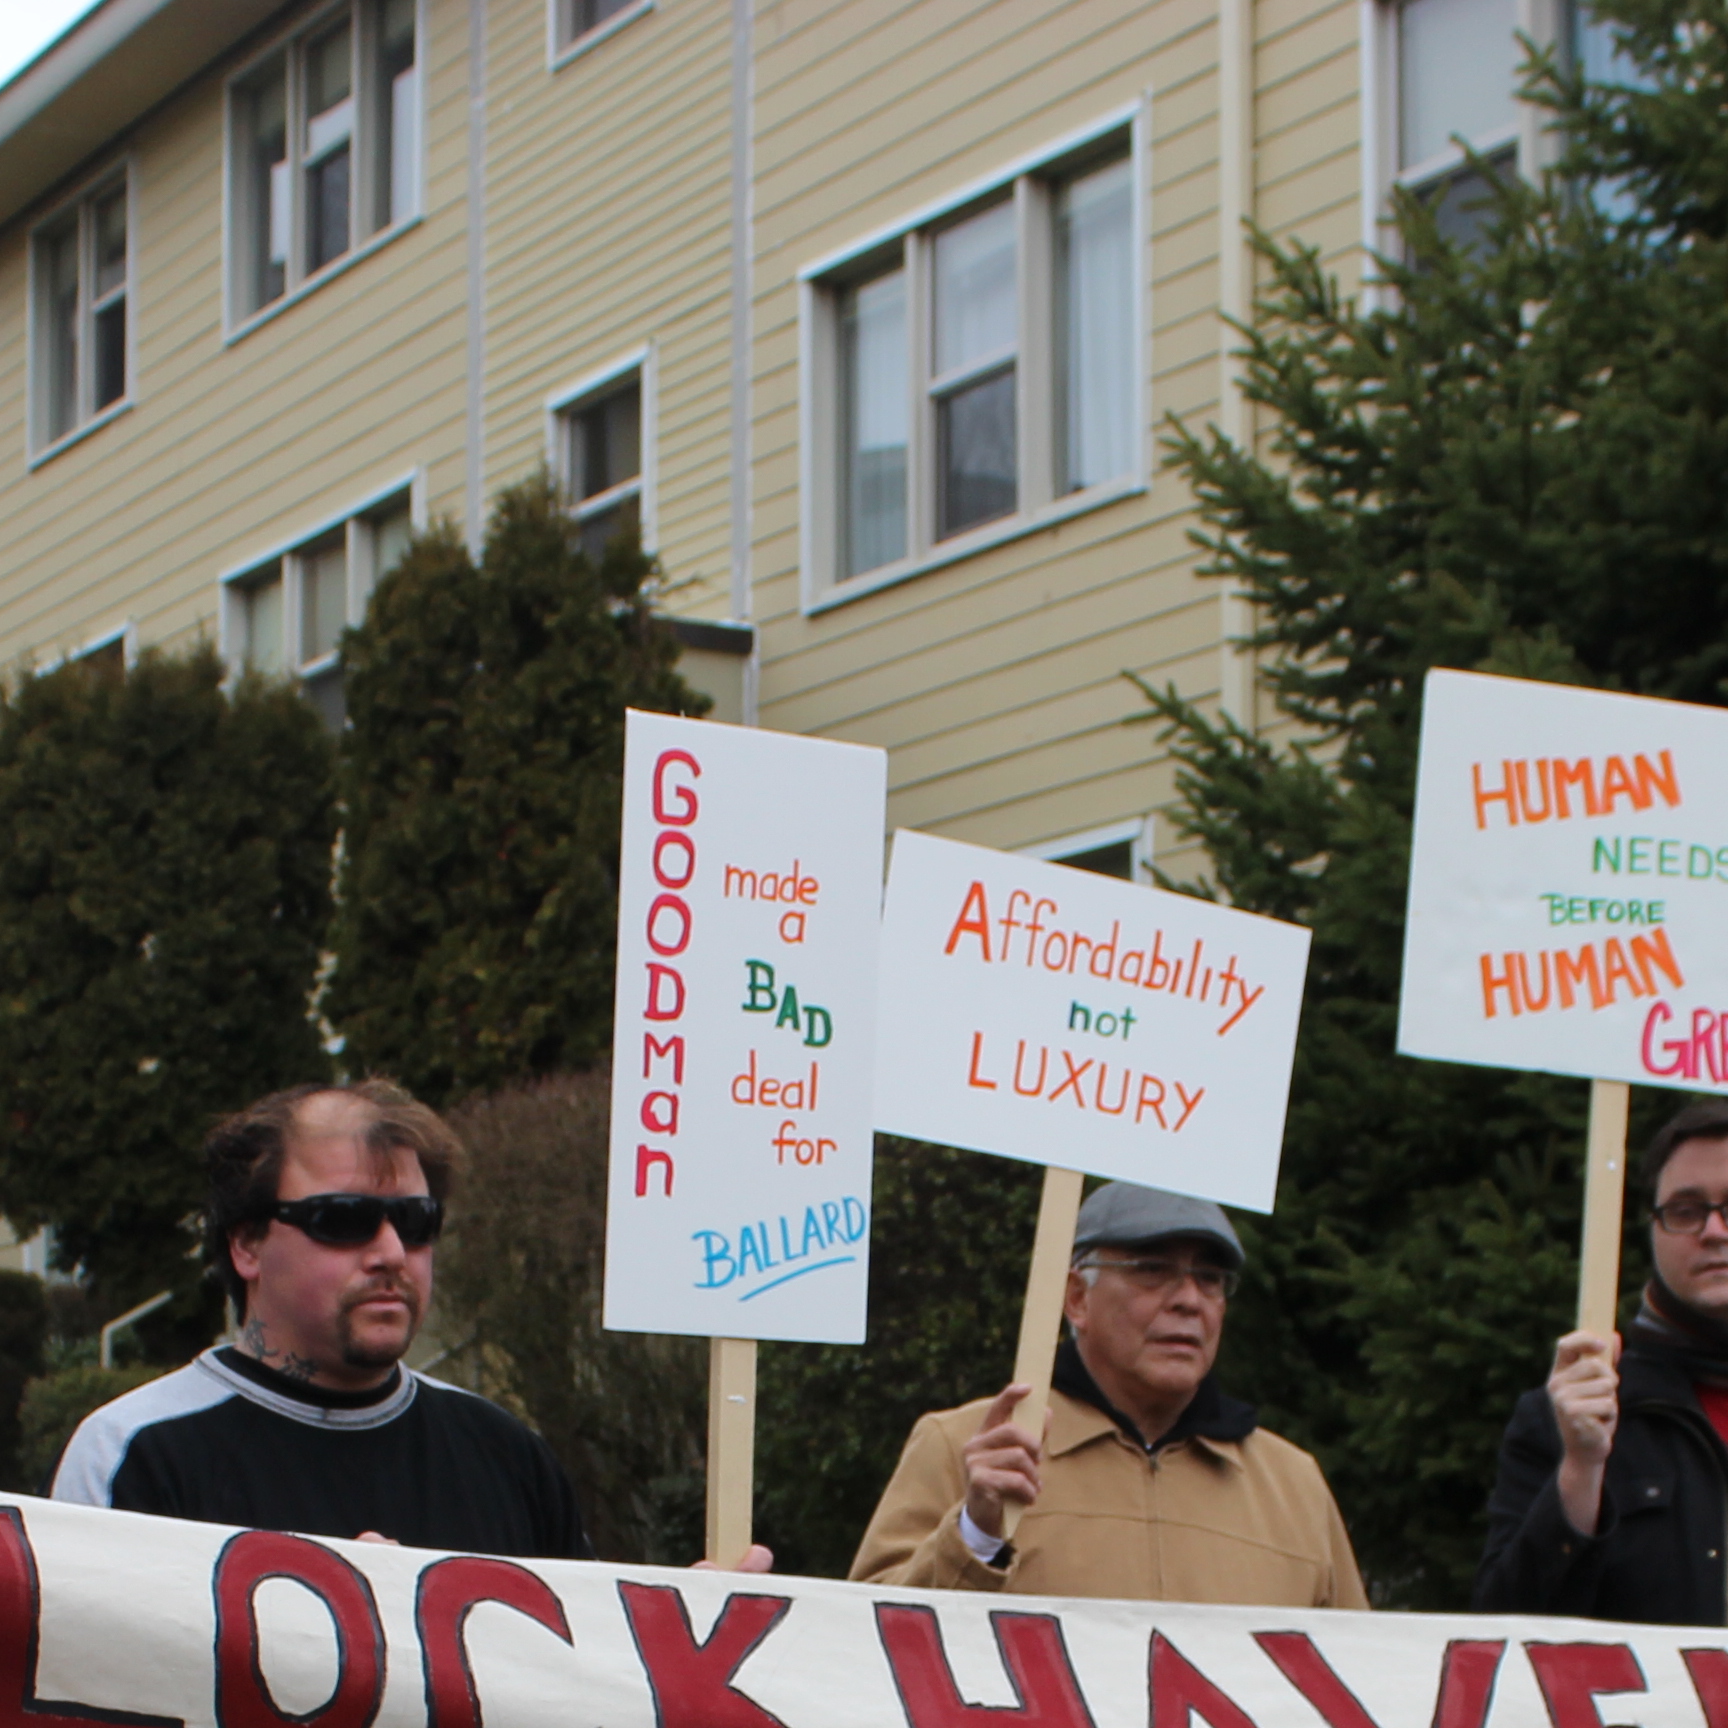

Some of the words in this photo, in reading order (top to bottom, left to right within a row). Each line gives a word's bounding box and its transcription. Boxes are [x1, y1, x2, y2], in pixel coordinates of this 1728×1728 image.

[1473, 749, 1682, 830] HUMAN
[724, 859, 820, 905] made
[1540, 893, 1666, 926] BEFORE
[779, 911, 805, 943] a
[944, 881, 1266, 1036] Affordability
[743, 960, 832, 1049] BAD
[1480, 926, 1684, 1019] HUMAN
[1068, 1000, 1138, 1041] not
[731, 1050, 818, 1111] deal
[968, 1031, 1205, 1133] LUXURY
[772, 1119, 838, 1166] for
[692, 1196, 866, 1289] BALLARD
